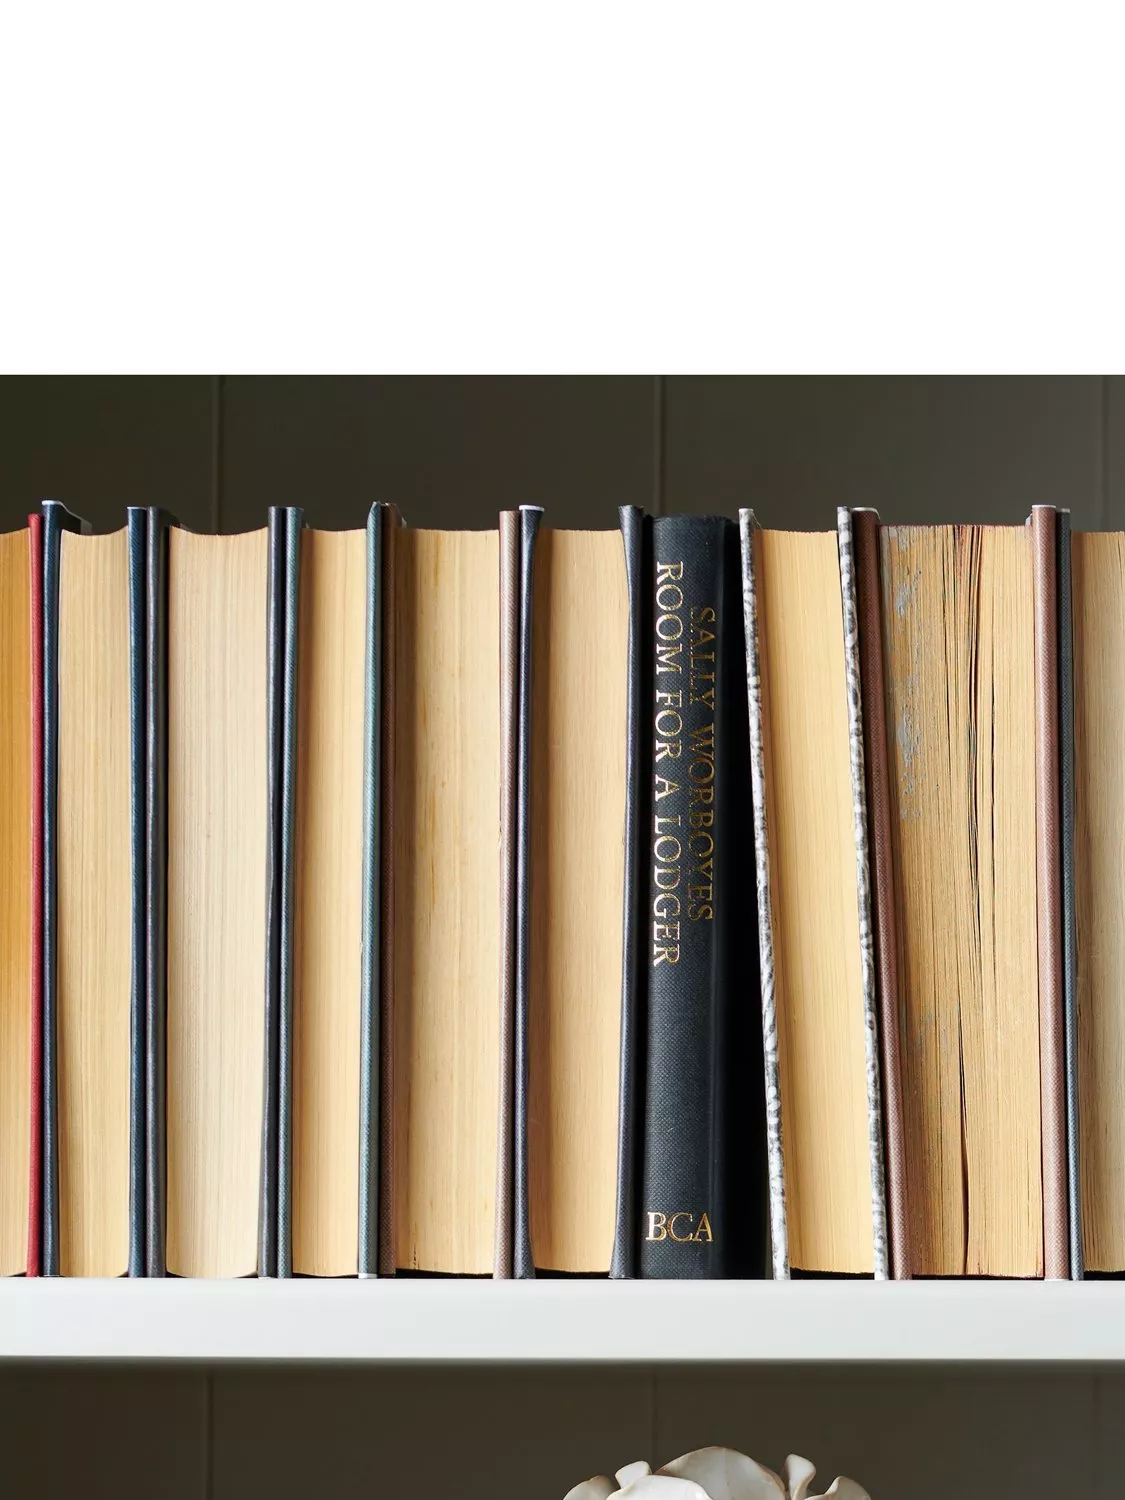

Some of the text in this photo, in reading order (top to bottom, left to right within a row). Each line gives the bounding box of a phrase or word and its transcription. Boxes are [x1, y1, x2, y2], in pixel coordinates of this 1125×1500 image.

[652, 561, 684, 967] ROOM FOR A LODGER
[686, 606, 716, 921] SALLY WORBOYES
[645, 1211, 714, 1242] BCA
